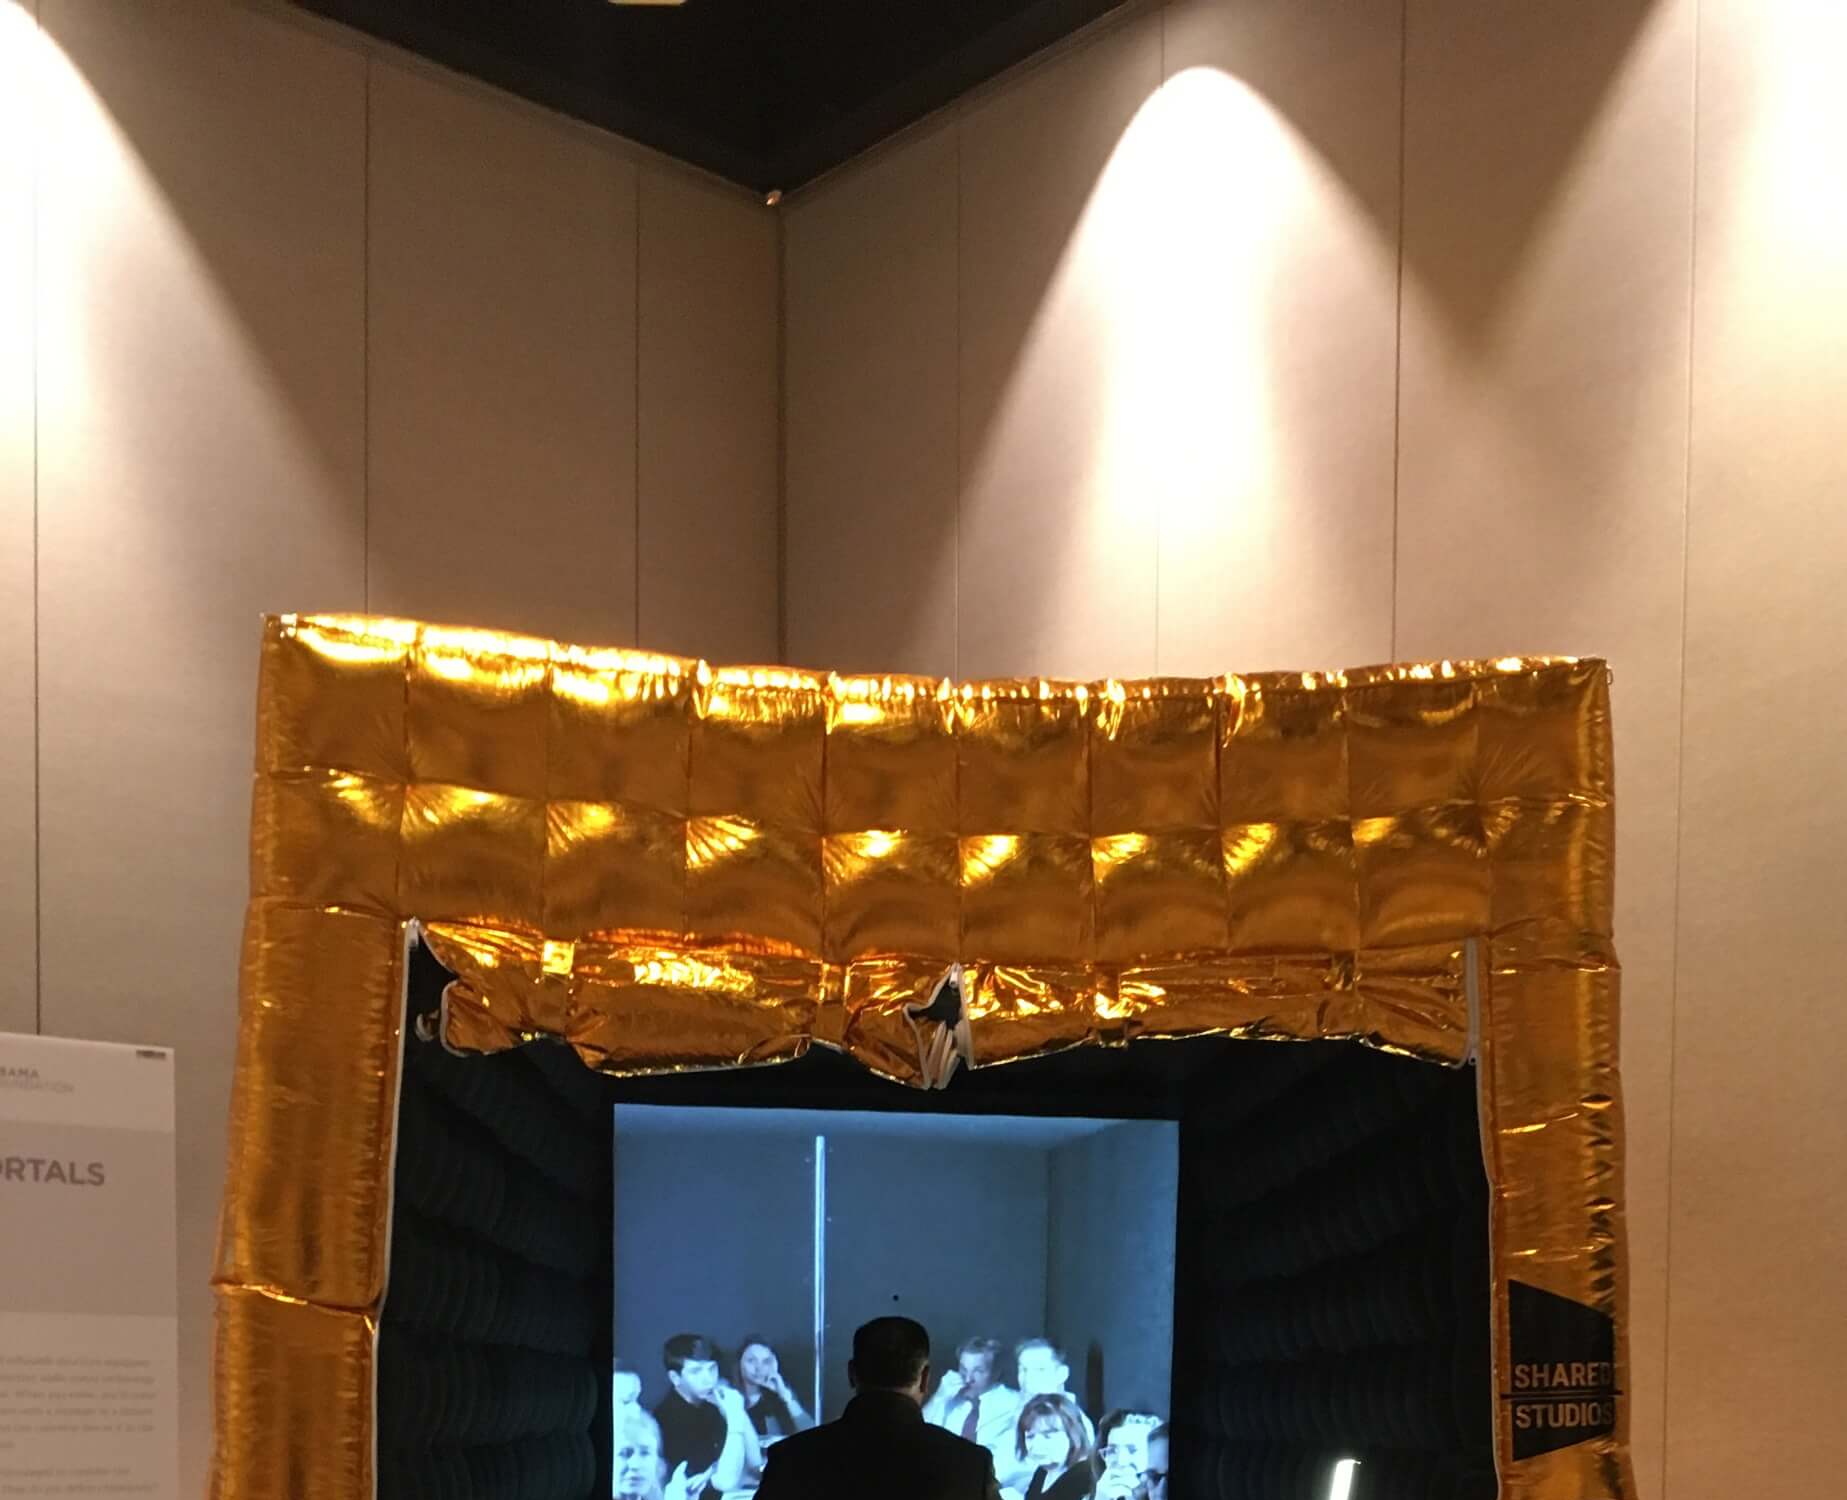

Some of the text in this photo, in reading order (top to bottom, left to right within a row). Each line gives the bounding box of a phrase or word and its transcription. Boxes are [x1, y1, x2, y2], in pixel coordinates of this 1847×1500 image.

[0, 1156, 105, 1187] RTALS
[1514, 1361, 1612, 1389] SHARED
[1515, 1402, 1613, 1429] STUDIOS
